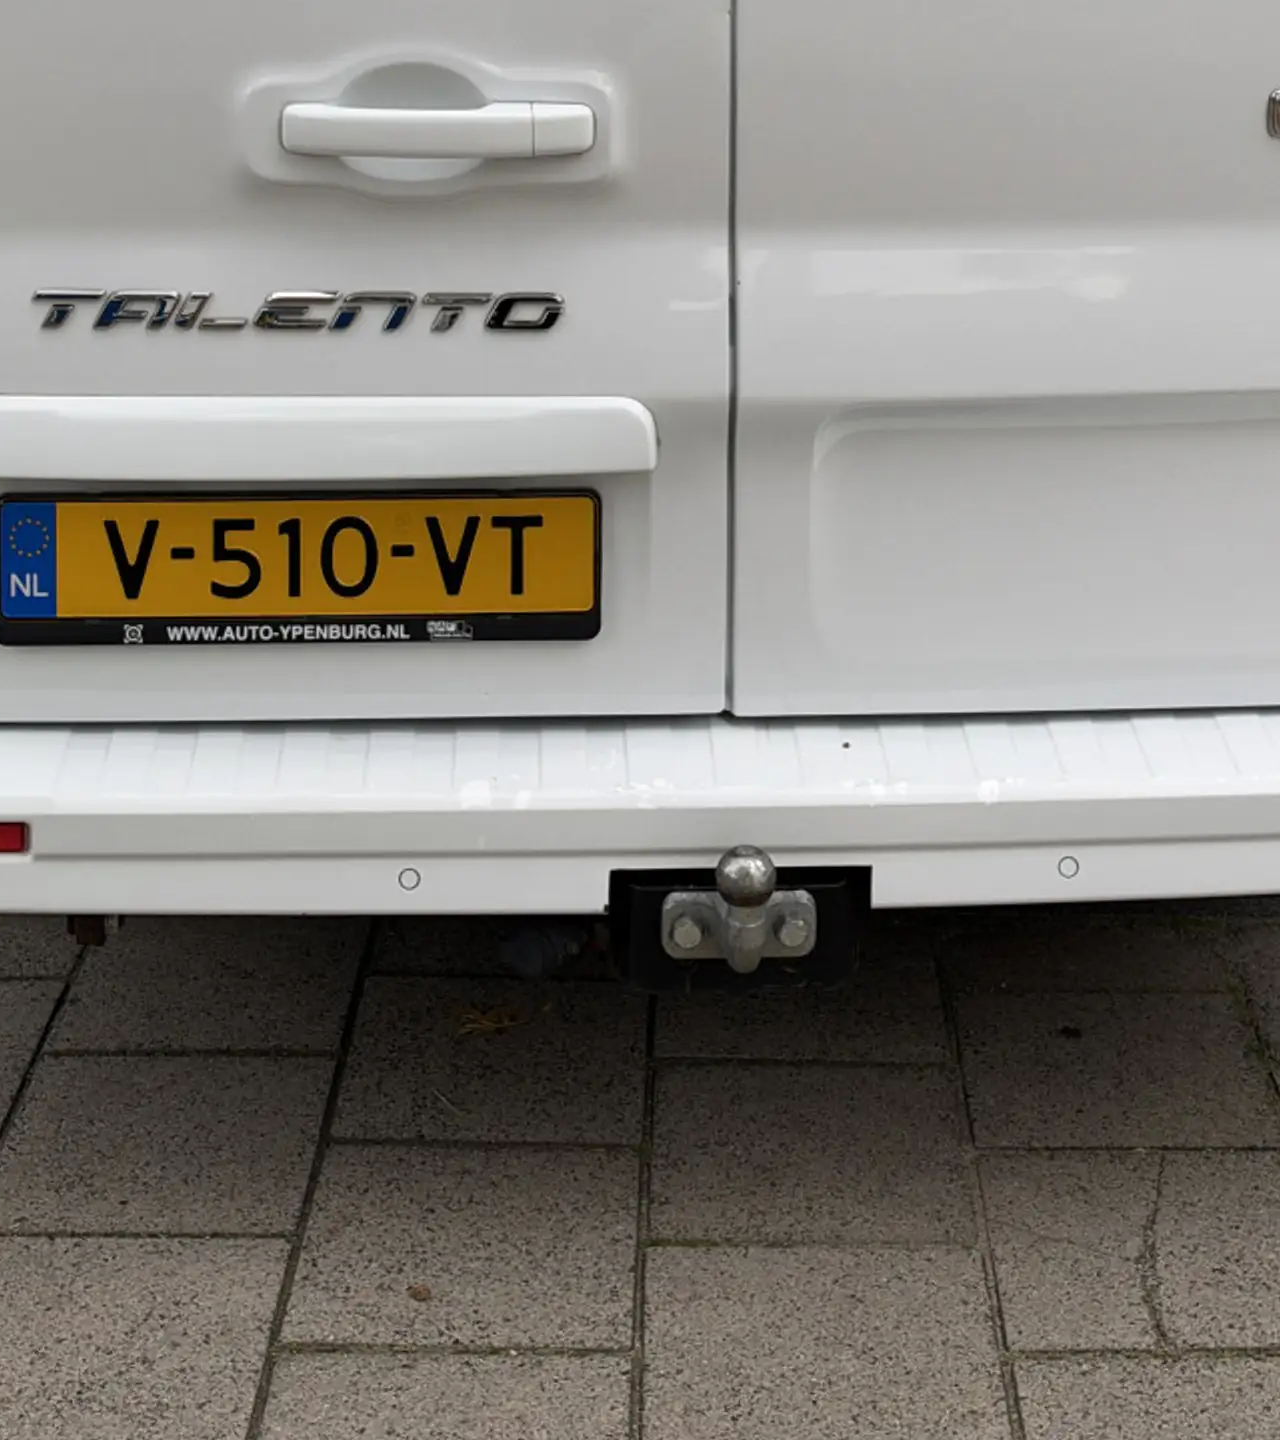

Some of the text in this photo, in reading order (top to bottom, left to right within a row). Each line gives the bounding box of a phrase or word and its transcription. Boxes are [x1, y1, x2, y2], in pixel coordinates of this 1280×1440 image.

[32, 288, 566, 334] TALENTO
[103, 515, 544, 601] V-510-VT
[9, 572, 49, 598] NL
[166, 623, 411, 642] WWW.AUTO-YPENBURG.NL
